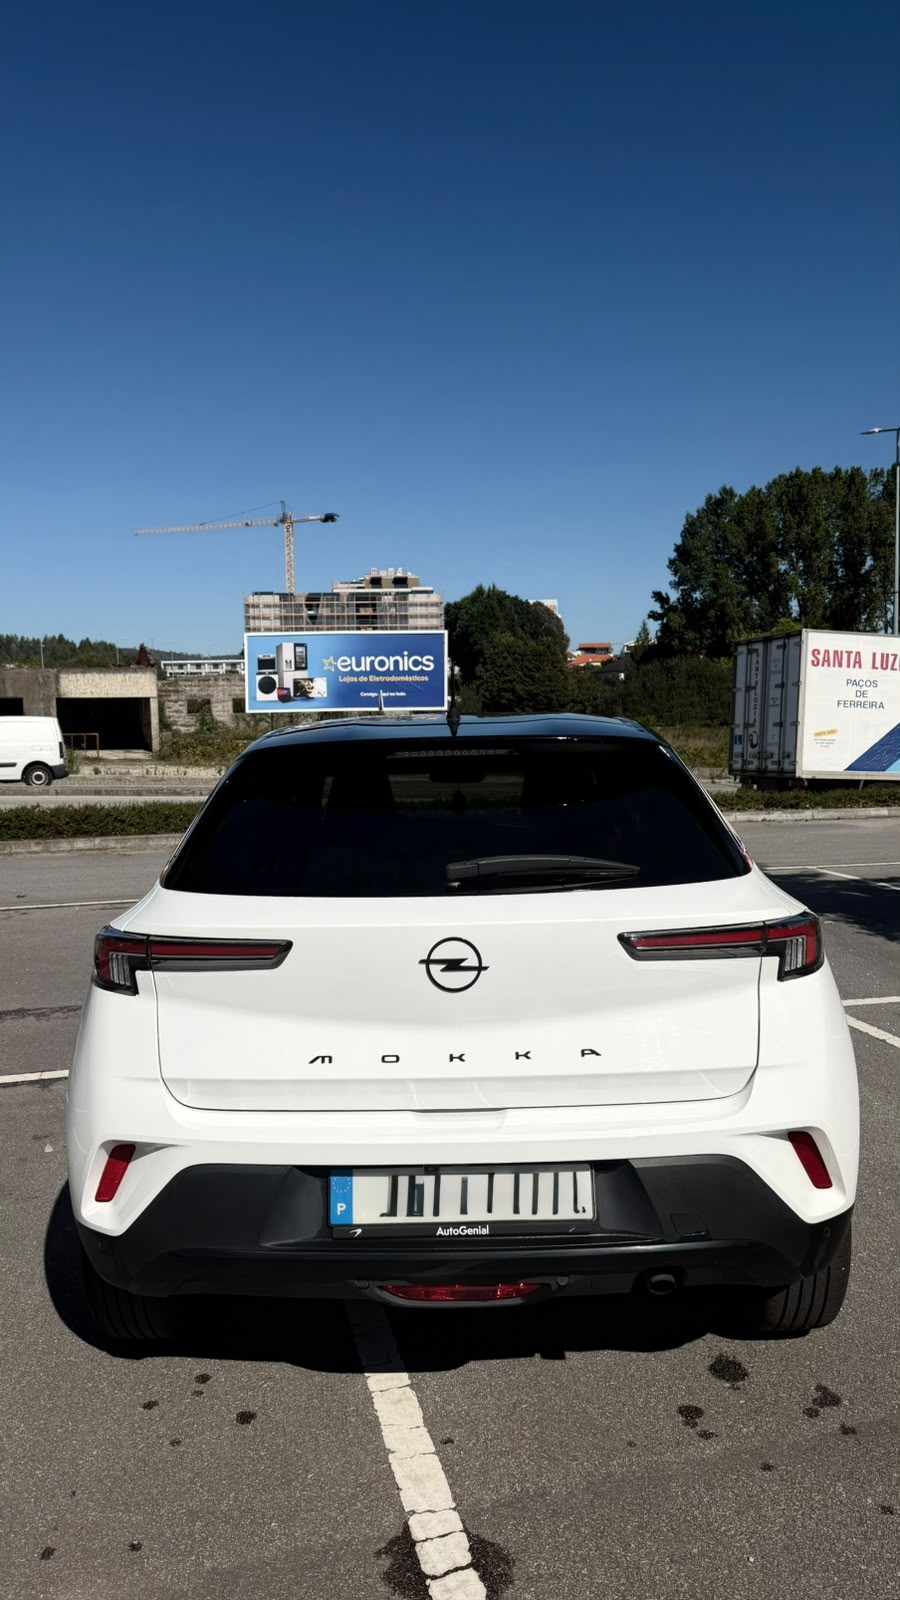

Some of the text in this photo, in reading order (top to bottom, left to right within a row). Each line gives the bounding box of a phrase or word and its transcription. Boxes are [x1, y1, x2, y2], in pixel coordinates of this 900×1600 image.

[337, 650, 435, 672] euronics
[811, 648, 900, 672] SANTA LUZ
[338, 675, 358, 684] Lojas
[846, 679, 878, 689] PAÇOS
[855, 690, 868, 698] DE
[837, 700, 885, 709] FERREIRA
[308, 1048, 601, 1064] MOKKA
[336, 1203, 346, 1216] P
[436, 1225, 489, 1236] AutoGenial
